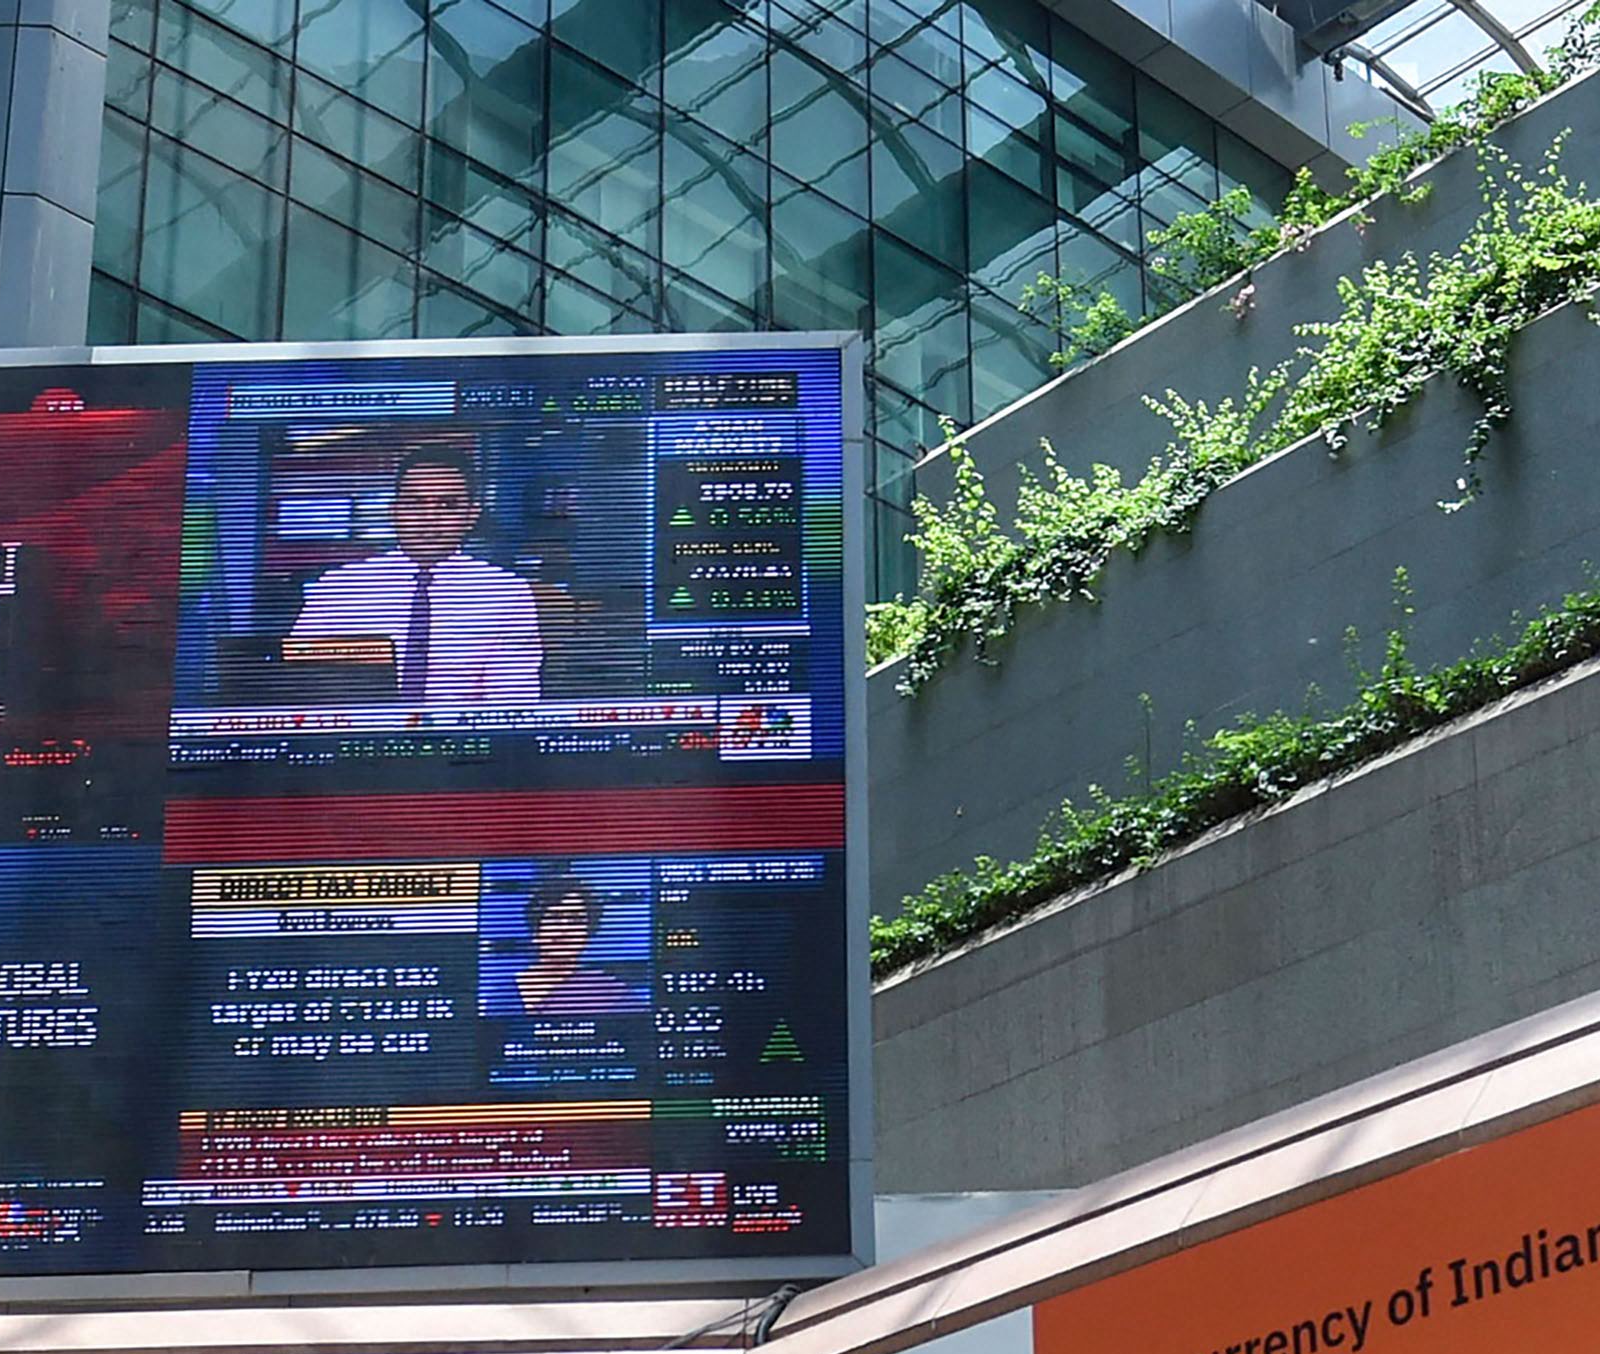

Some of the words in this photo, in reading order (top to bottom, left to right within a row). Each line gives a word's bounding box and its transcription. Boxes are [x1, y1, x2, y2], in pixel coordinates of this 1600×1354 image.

[219, 872, 308, 901] DIRECT
[314, 871, 356, 899] TAX
[365, 868, 456, 898] TARGET
[305, 965, 388, 989] direct
[394, 965, 439, 988] tax
[211, 1001, 296, 1030] target
[271, 1032, 333, 1061] may
[655, 1172, 726, 1208] ET
[733, 1185, 779, 1205] LIVE
[1387, 1267, 1433, 1327] of
